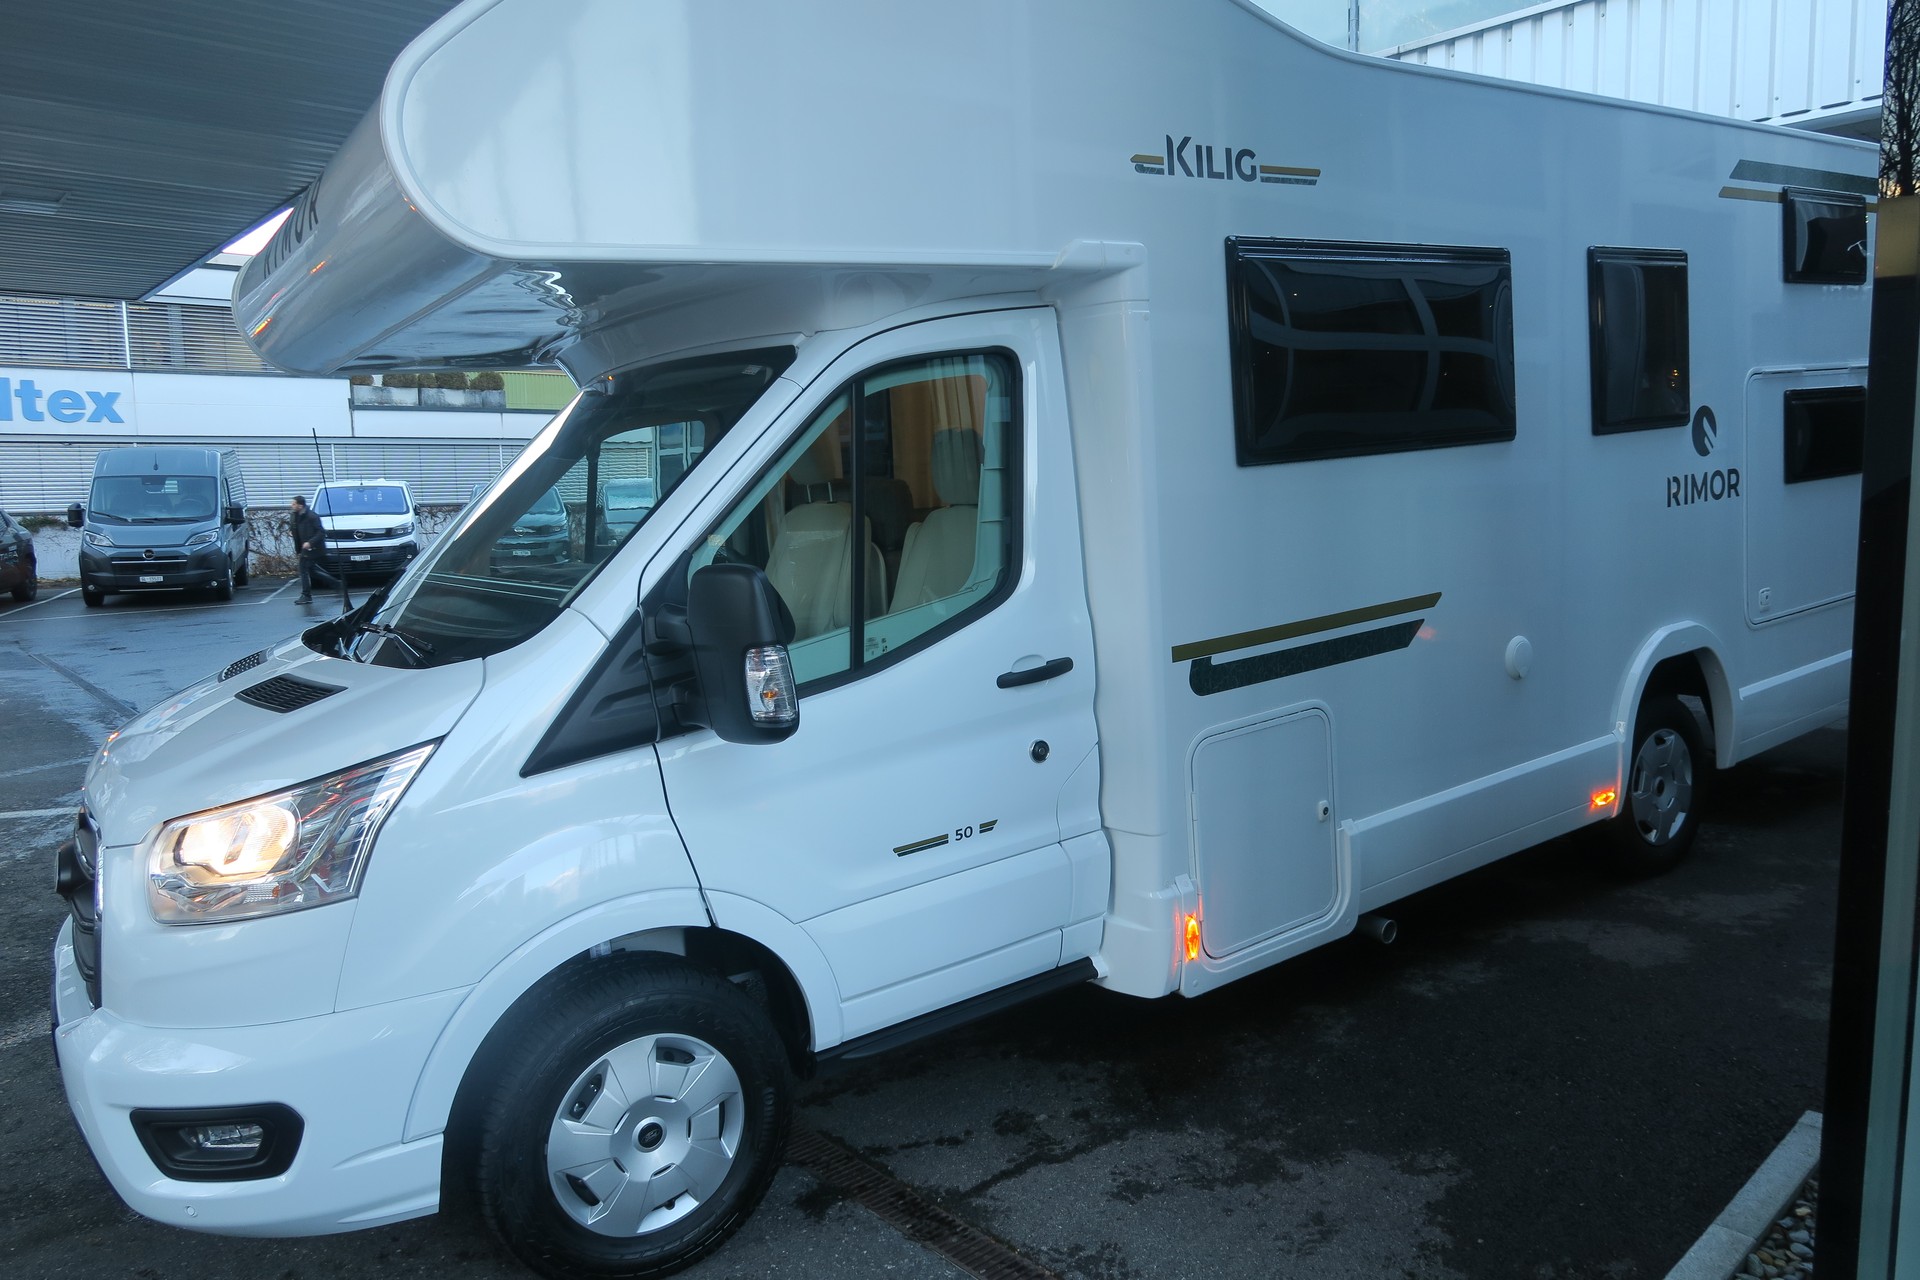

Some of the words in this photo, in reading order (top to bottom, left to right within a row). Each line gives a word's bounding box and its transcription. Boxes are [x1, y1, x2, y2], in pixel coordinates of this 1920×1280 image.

[1166, 134, 1257, 182] KILIG
[1667, 468, 1741, 508] RIMOR
[954, 826, 974, 842] 50
